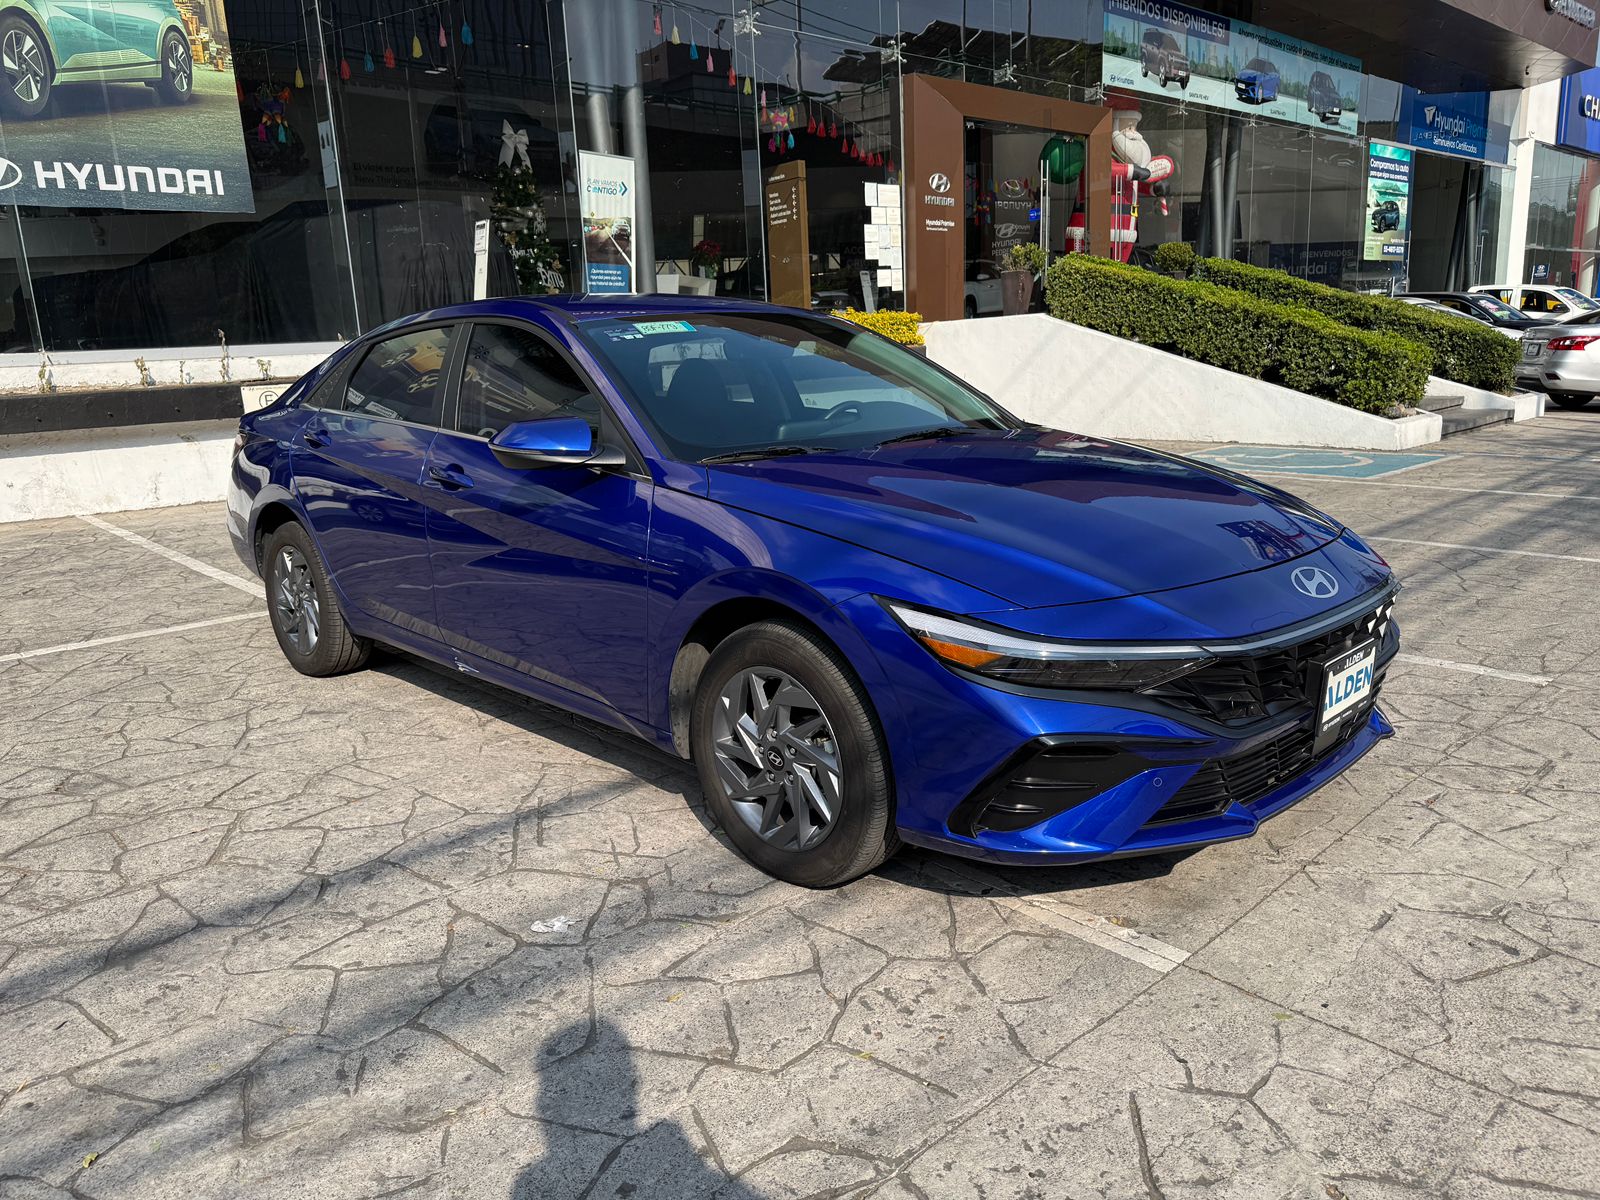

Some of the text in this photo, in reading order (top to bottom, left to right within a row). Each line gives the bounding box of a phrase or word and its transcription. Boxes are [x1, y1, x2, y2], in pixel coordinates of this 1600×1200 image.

[1163, 7, 1226, 38] DISPONIBLES!
[1584, 94, 1600, 120] CH
[1434, 110, 1466, 133] Hyundai
[1433, 135, 1456, 149] Seminuevos
[33, 160, 225, 196] HYUNDAI
[924, 195, 955, 207] HYUNDAI
